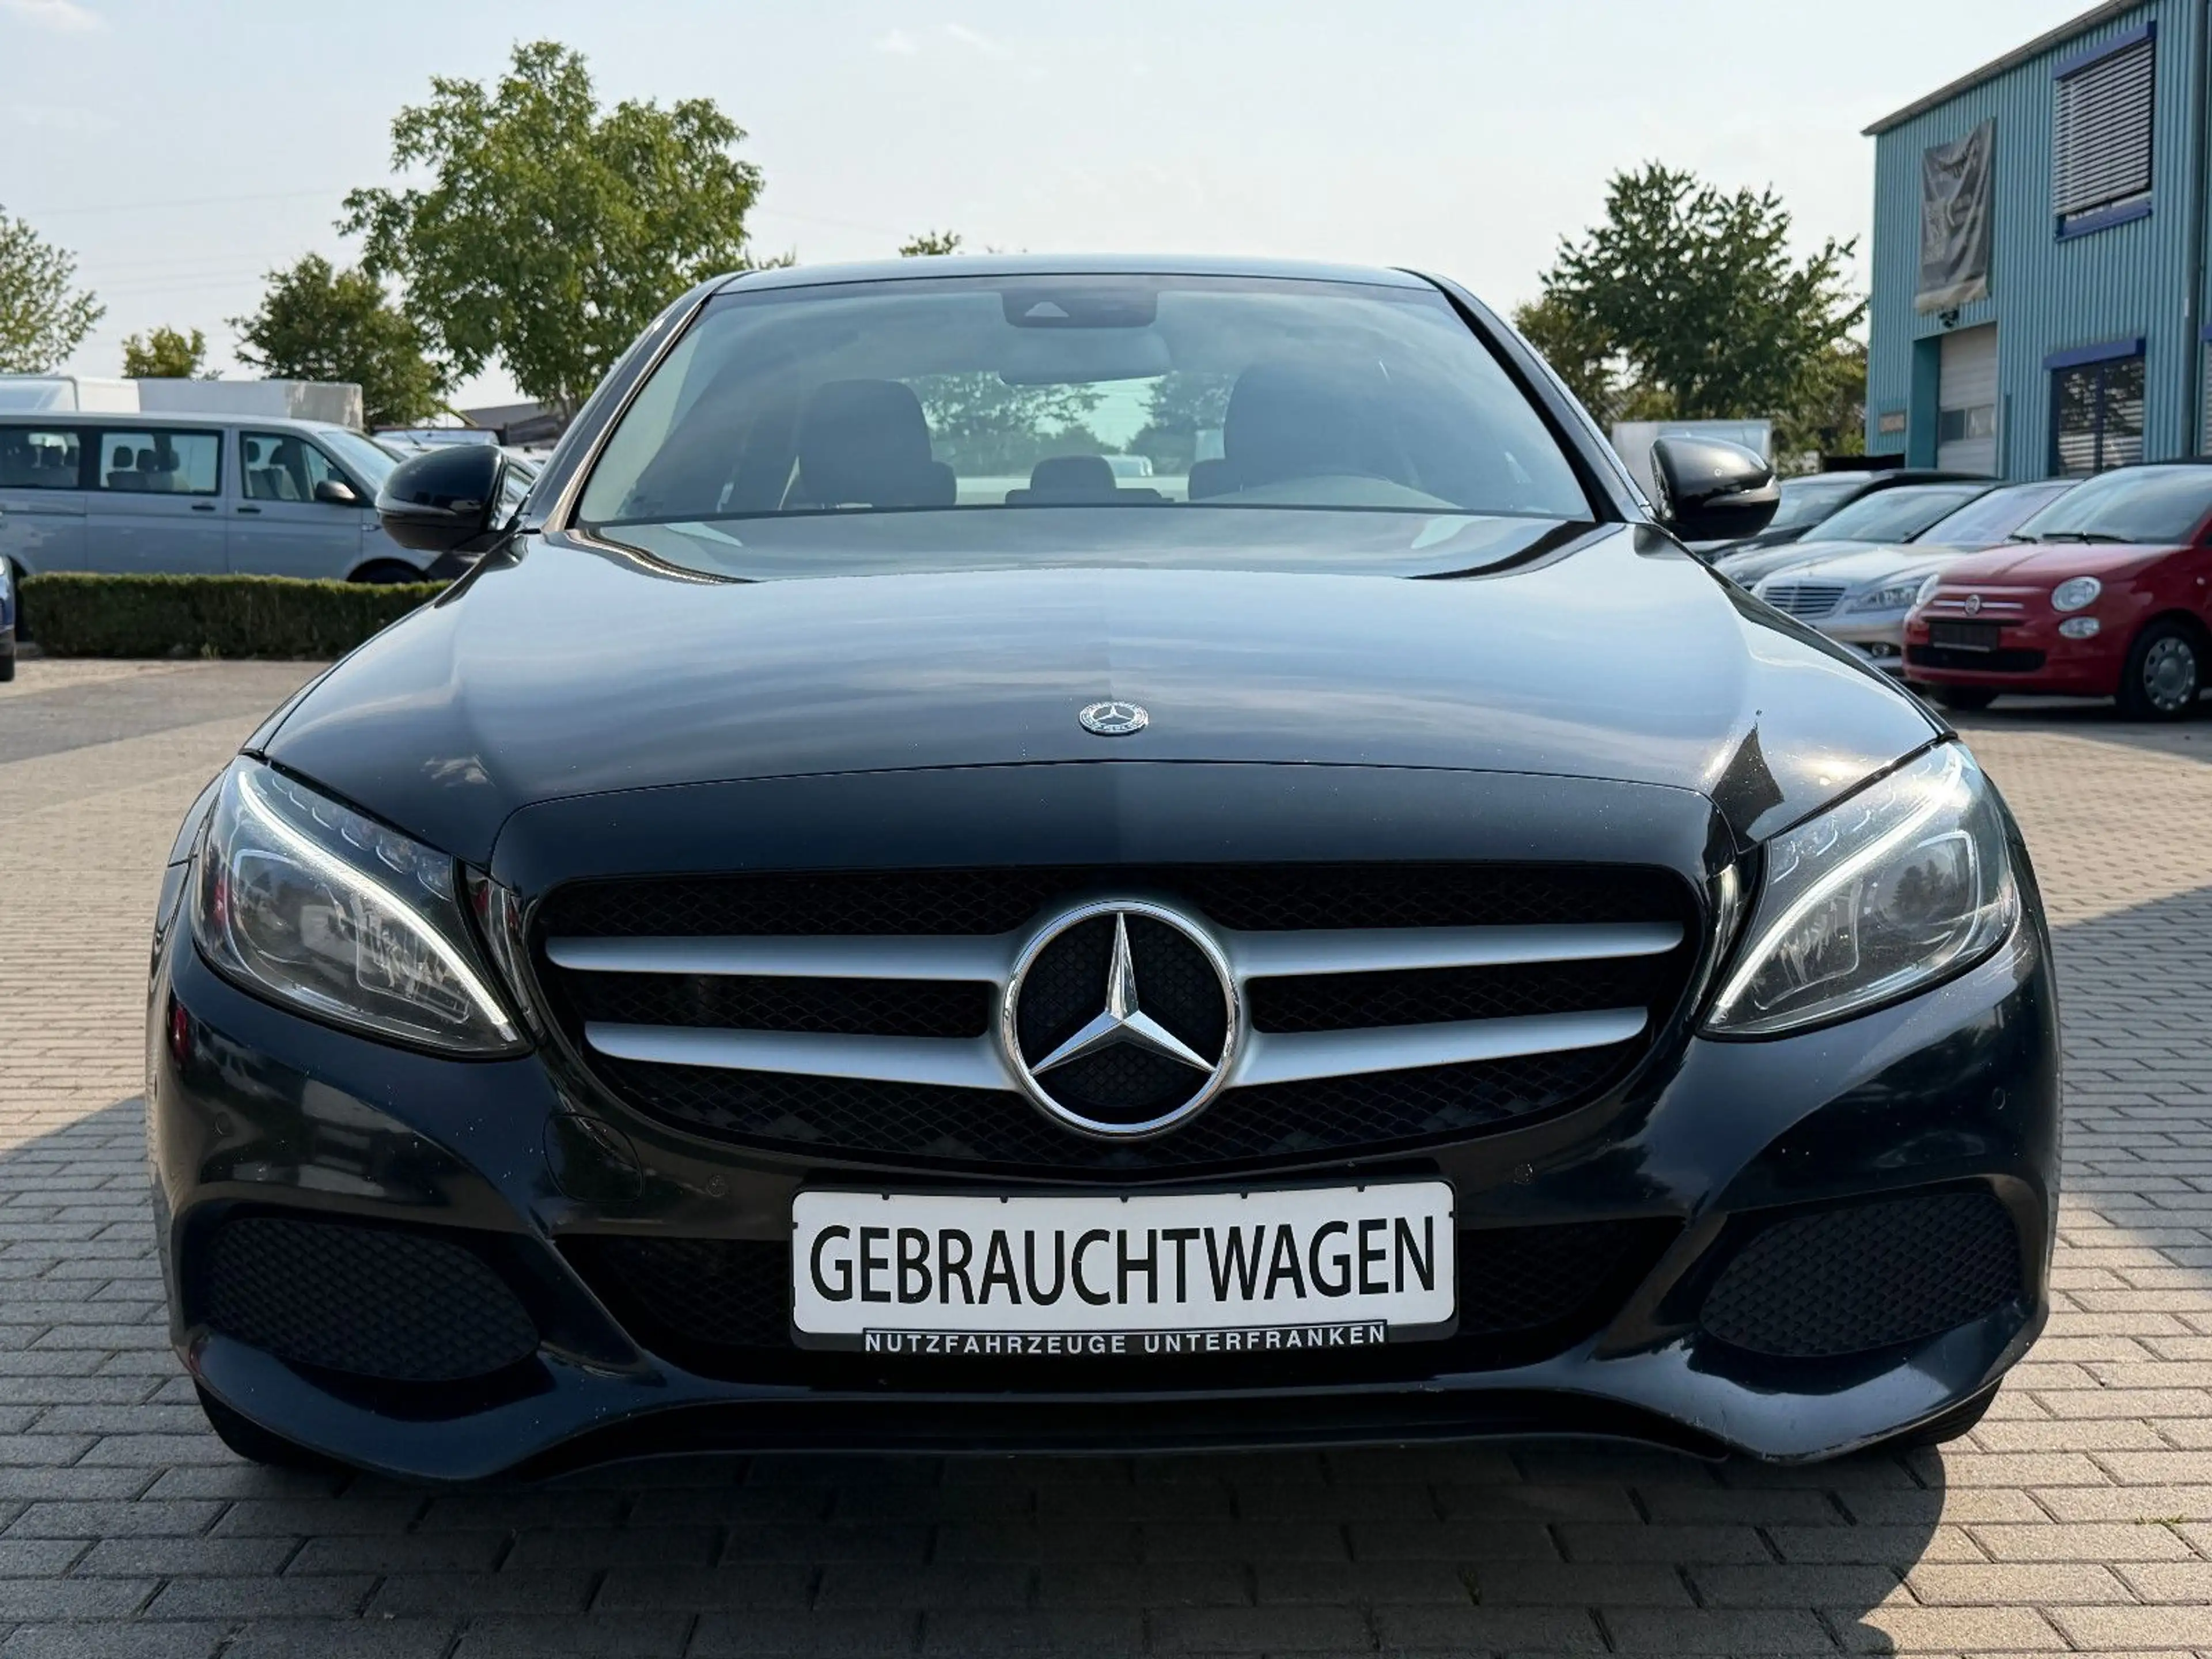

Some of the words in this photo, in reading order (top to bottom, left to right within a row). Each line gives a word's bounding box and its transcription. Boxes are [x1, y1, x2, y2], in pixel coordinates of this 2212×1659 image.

[810, 1215, 1434, 1306] GEBRAUCHTWAGEN
[865, 1334, 1126, 1354] NUTZFAHRZEUGE
[1145, 1325, 1384, 1353] UNTERFRANKEN
